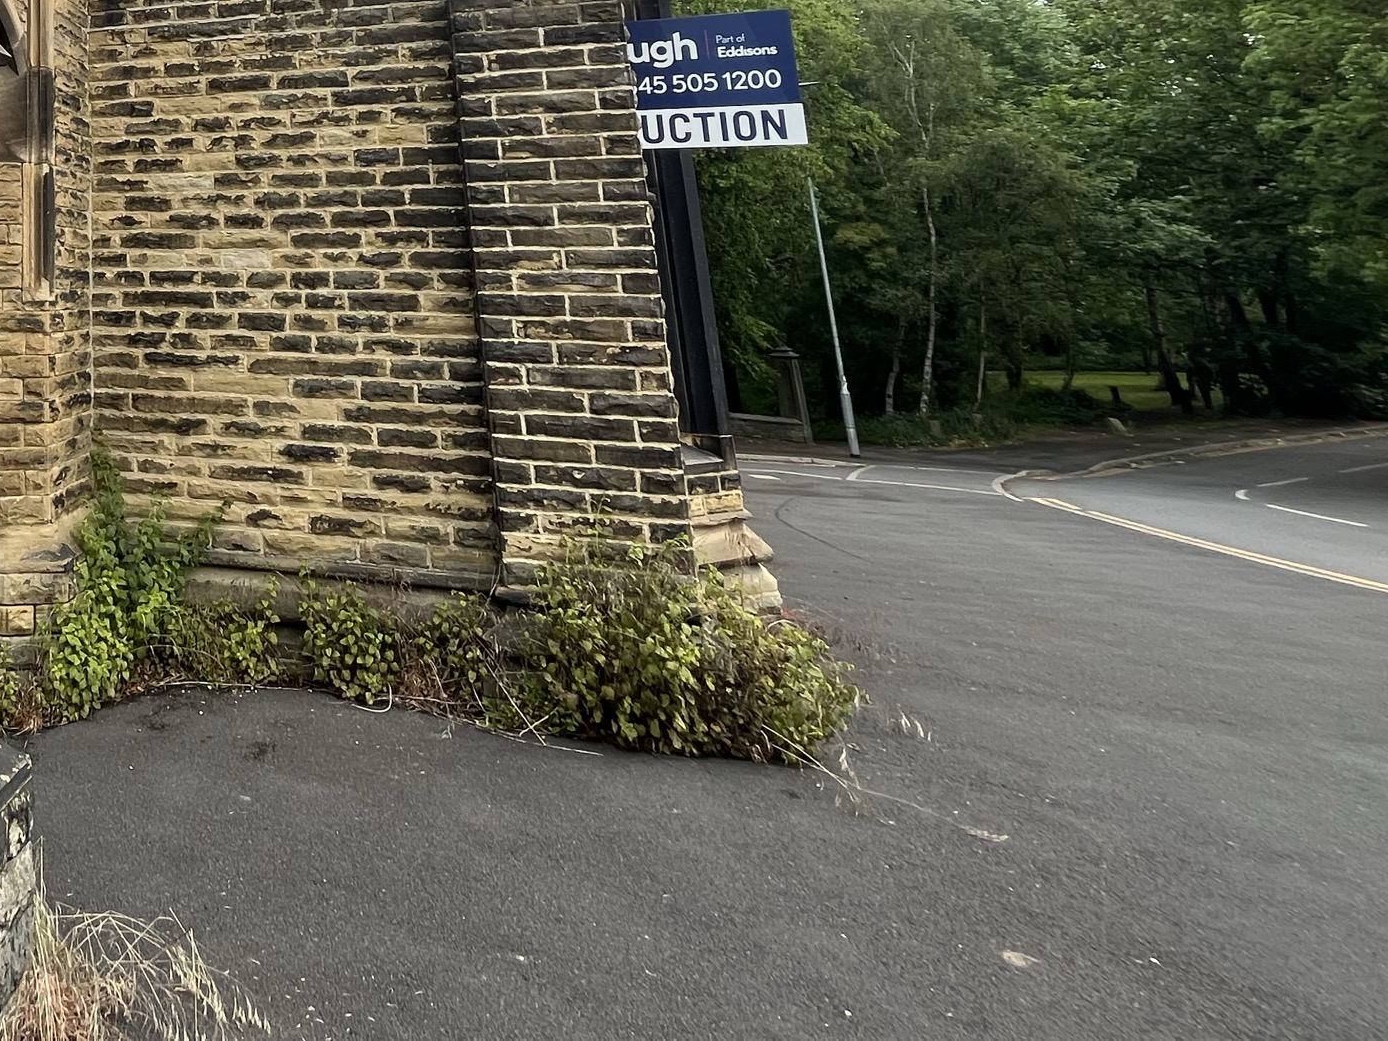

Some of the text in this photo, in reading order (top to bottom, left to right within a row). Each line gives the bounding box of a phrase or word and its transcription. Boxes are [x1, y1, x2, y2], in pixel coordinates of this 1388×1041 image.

[627, 32, 698, 68] ugh
[715, 33, 746, 44] Part of
[717, 45, 778, 58] Eddisons
[634, 69, 782, 95] 45 505 1200
[641, 109, 788, 144] UCTION
